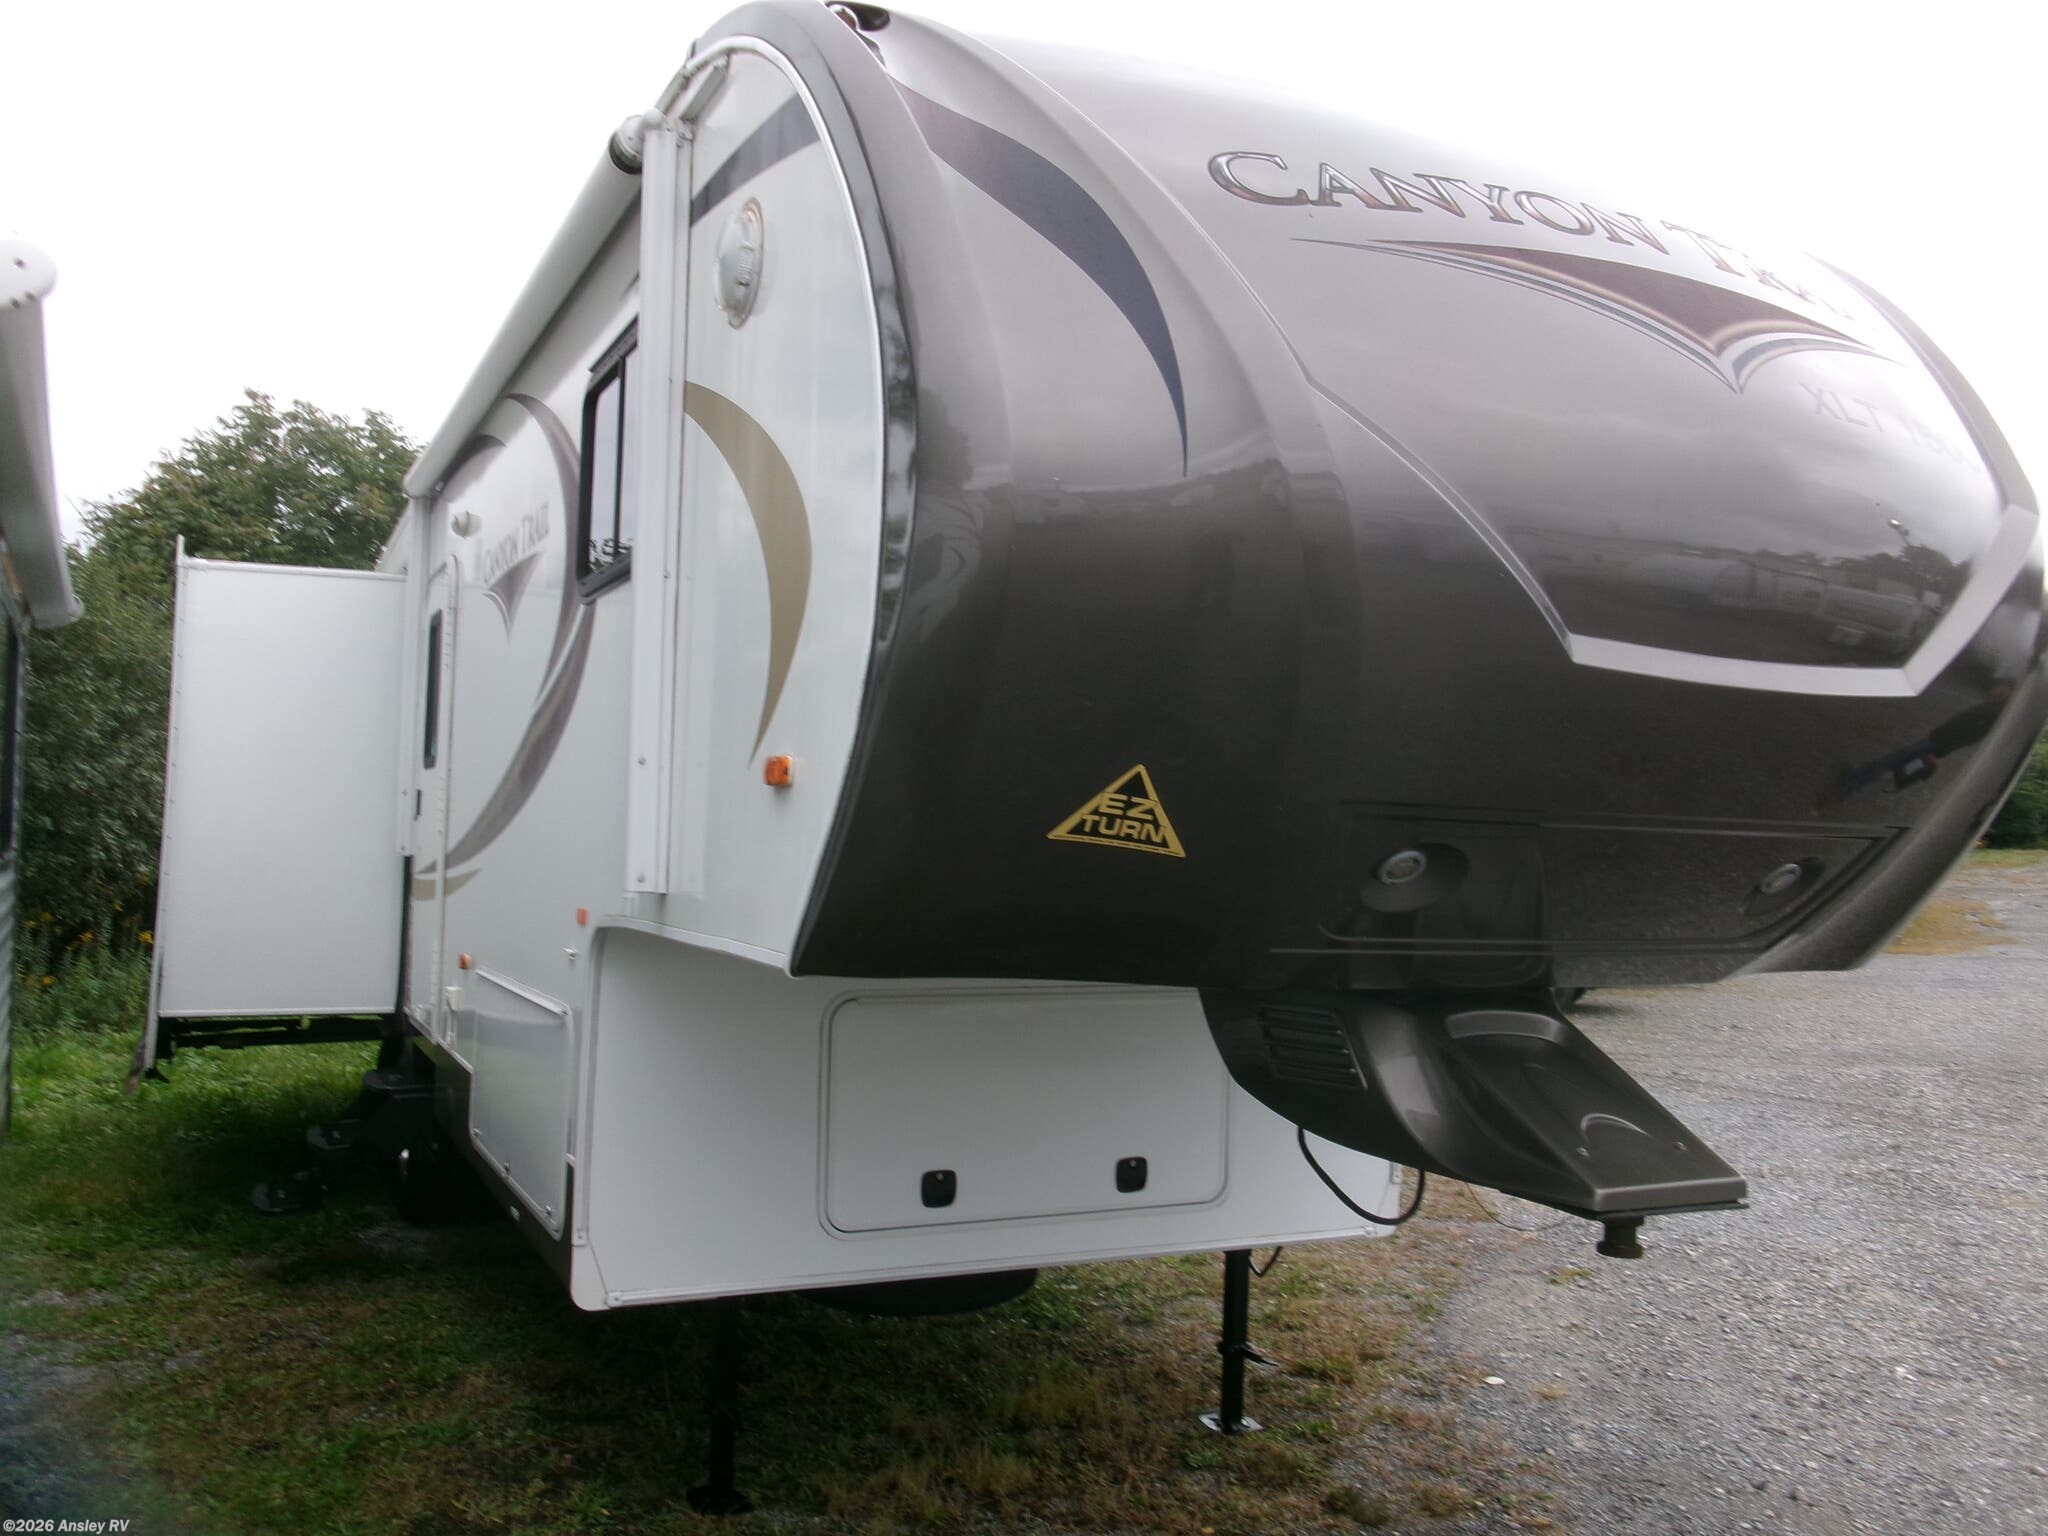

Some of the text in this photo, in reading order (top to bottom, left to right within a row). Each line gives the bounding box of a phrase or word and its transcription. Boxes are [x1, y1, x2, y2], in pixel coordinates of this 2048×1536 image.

[1206, 150, 1671, 256] CANYON
[1799, 382, 1885, 433] XLT
[1098, 793, 1158, 821] EZ
[1081, 814, 1168, 844] TURN
